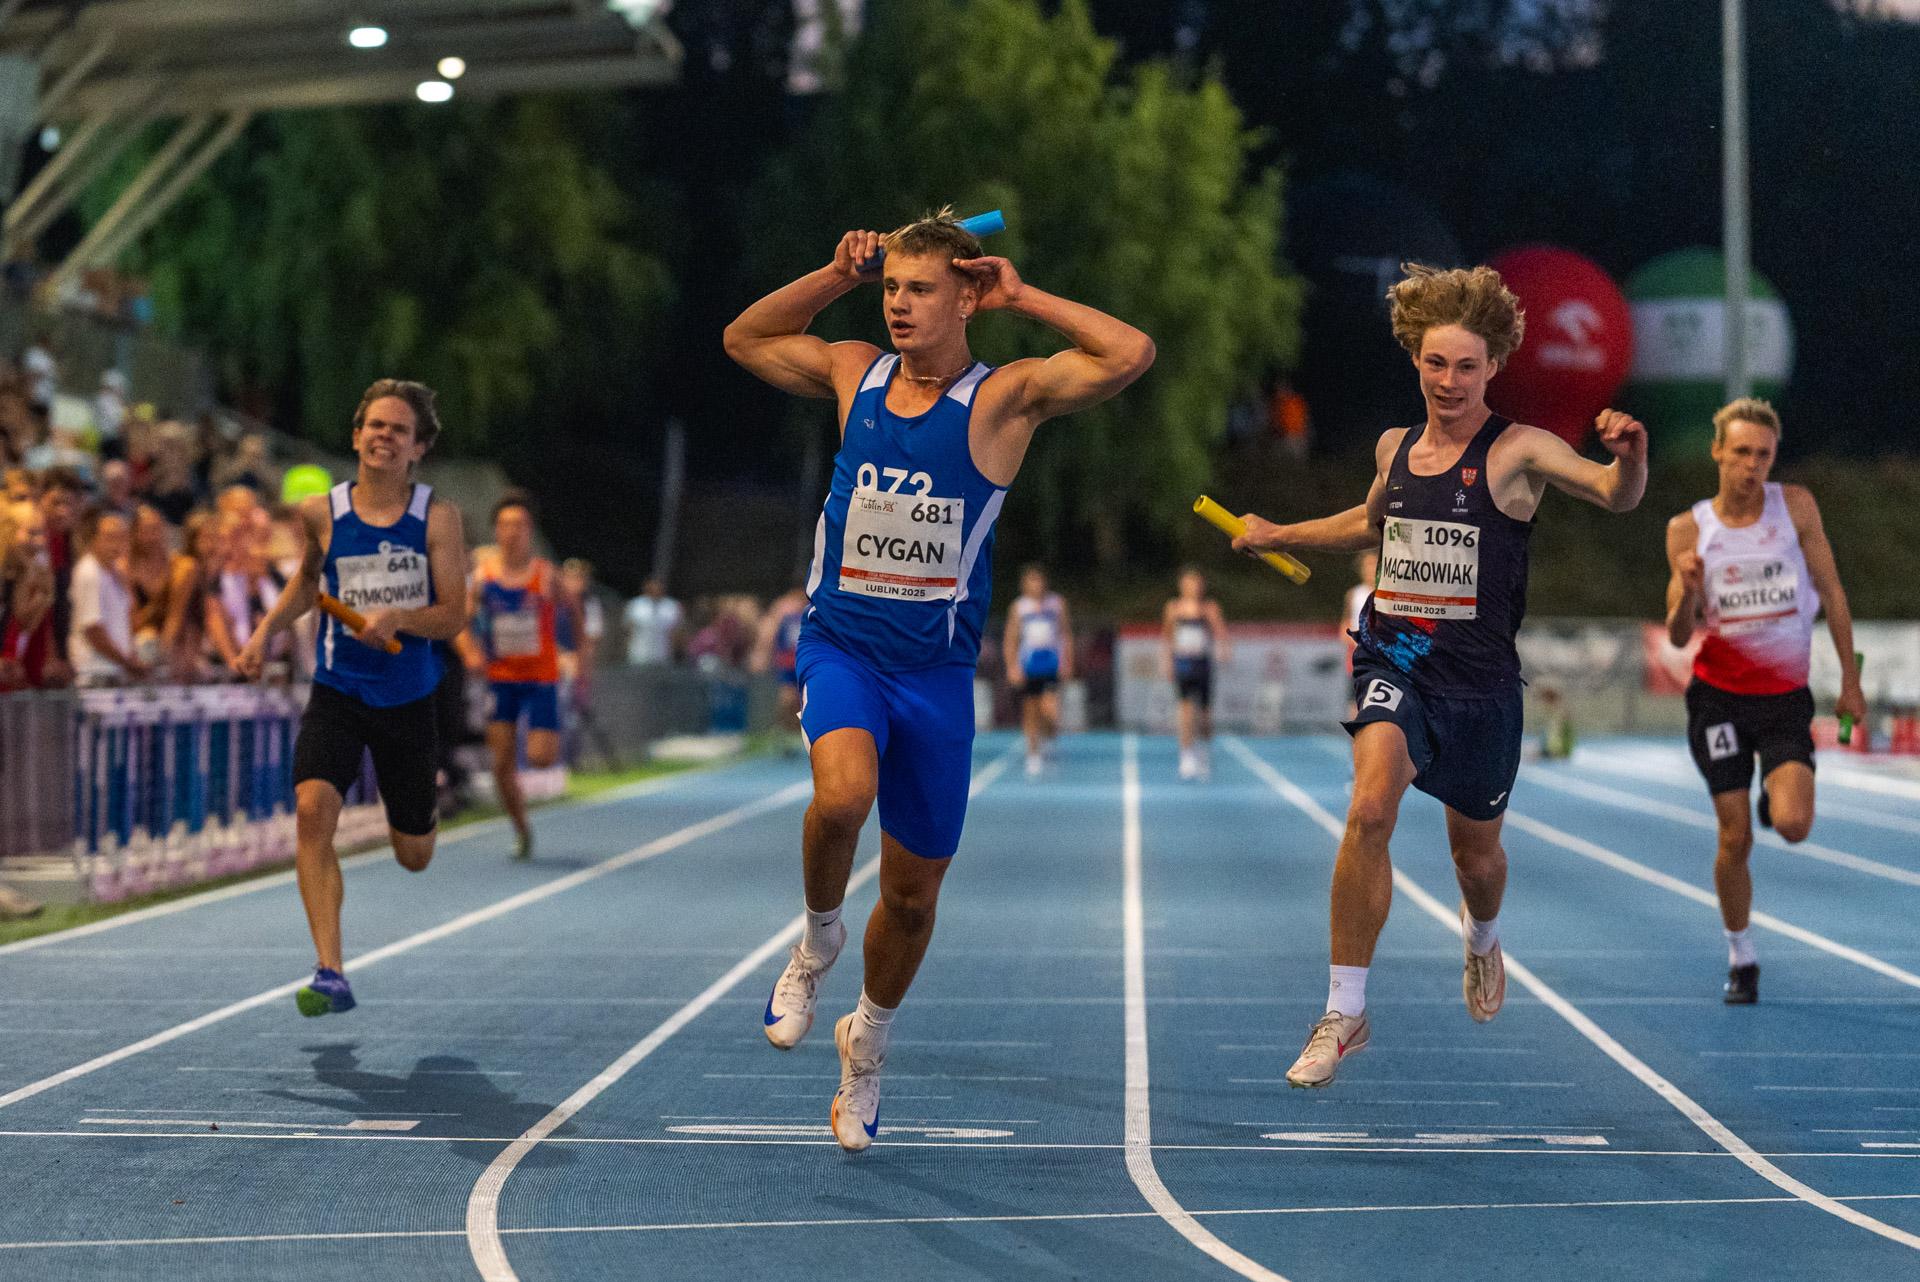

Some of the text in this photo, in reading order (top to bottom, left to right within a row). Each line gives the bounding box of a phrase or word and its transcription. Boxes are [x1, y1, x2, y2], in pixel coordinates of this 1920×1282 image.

[911, 503, 953, 524] 681
[1424, 526, 1475, 548] 1096
[857, 533, 945, 564] CYGAN
[387, 555, 420, 573] 641
[1383, 557, 1473, 585] MĄCZKOWIAK
[865, 584, 926, 597] LUBLIN 2025
[1719, 586, 1795, 609] KOSTECKI
[1393, 604, 1446, 615] LUBLIN 2025
[1369, 681, 1395, 703] 5
[1714, 728, 1731, 752] 4
